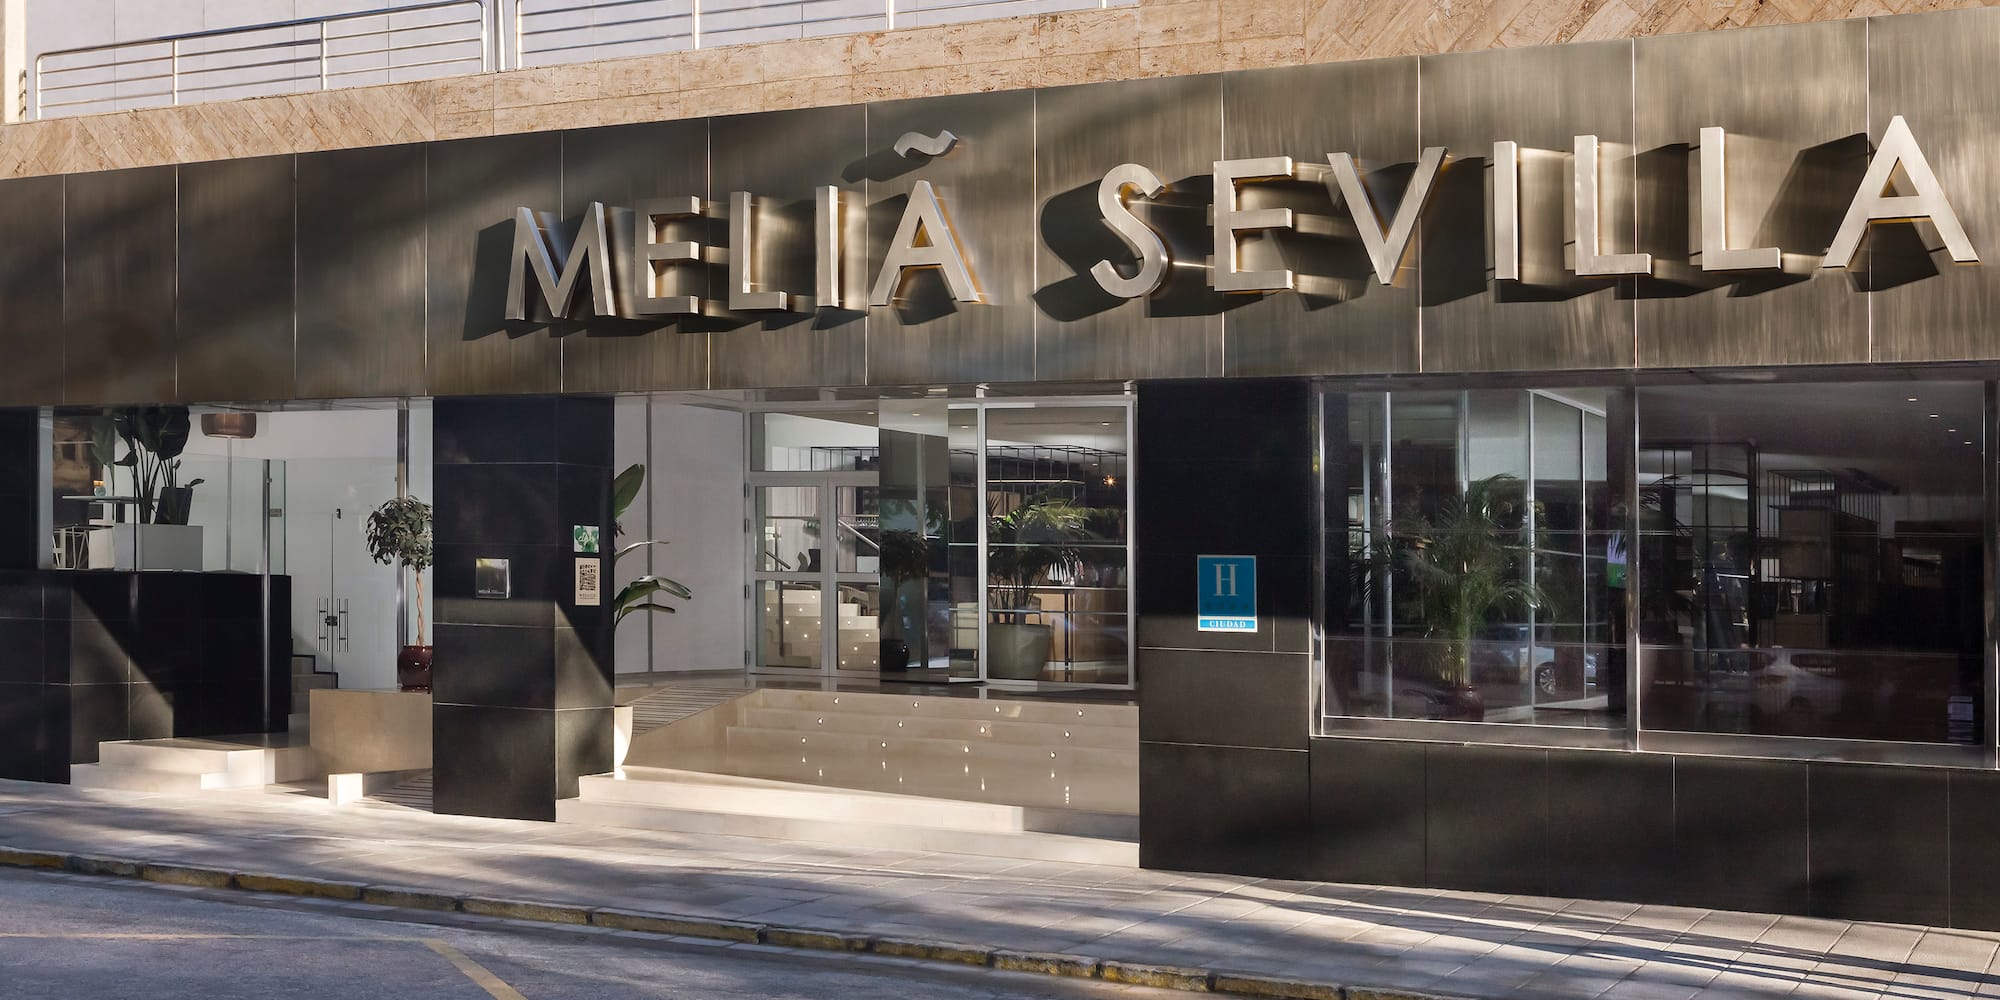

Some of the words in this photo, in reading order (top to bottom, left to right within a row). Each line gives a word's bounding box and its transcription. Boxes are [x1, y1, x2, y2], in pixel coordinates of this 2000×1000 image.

[1090, 114, 1982, 299] SEVILLA
[1213, 563, 1239, 596] H
[1209, 620, 1246, 628] CIUDAD
